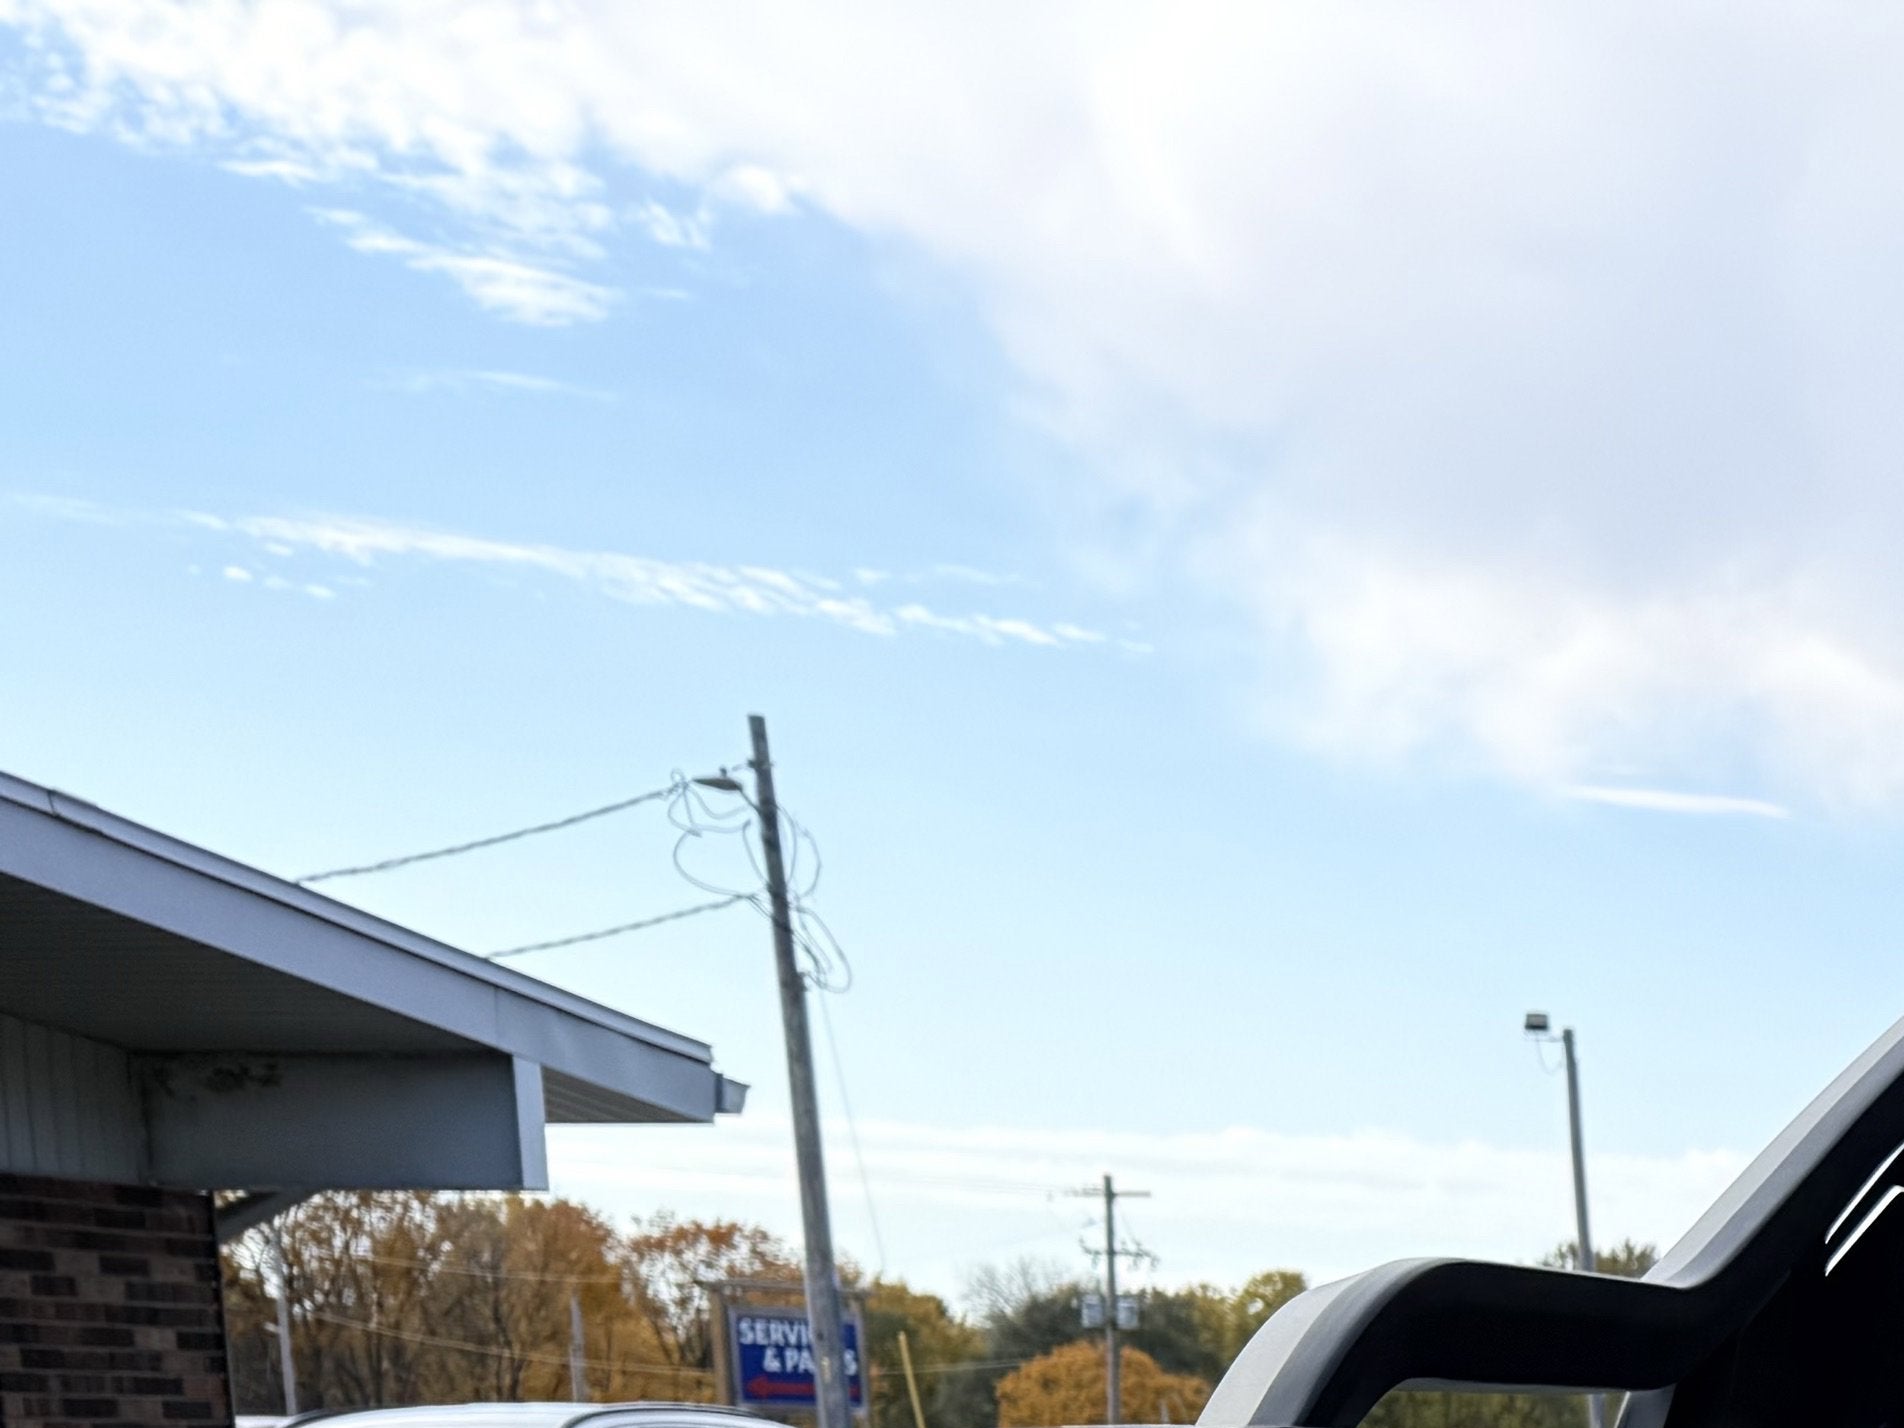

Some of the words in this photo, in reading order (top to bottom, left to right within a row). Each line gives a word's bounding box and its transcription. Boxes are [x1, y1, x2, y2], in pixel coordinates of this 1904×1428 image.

[738, 1316, 812, 1347] SERVI
[762, 1346, 782, 1373] &
[784, 1347, 858, 1377] PAS
